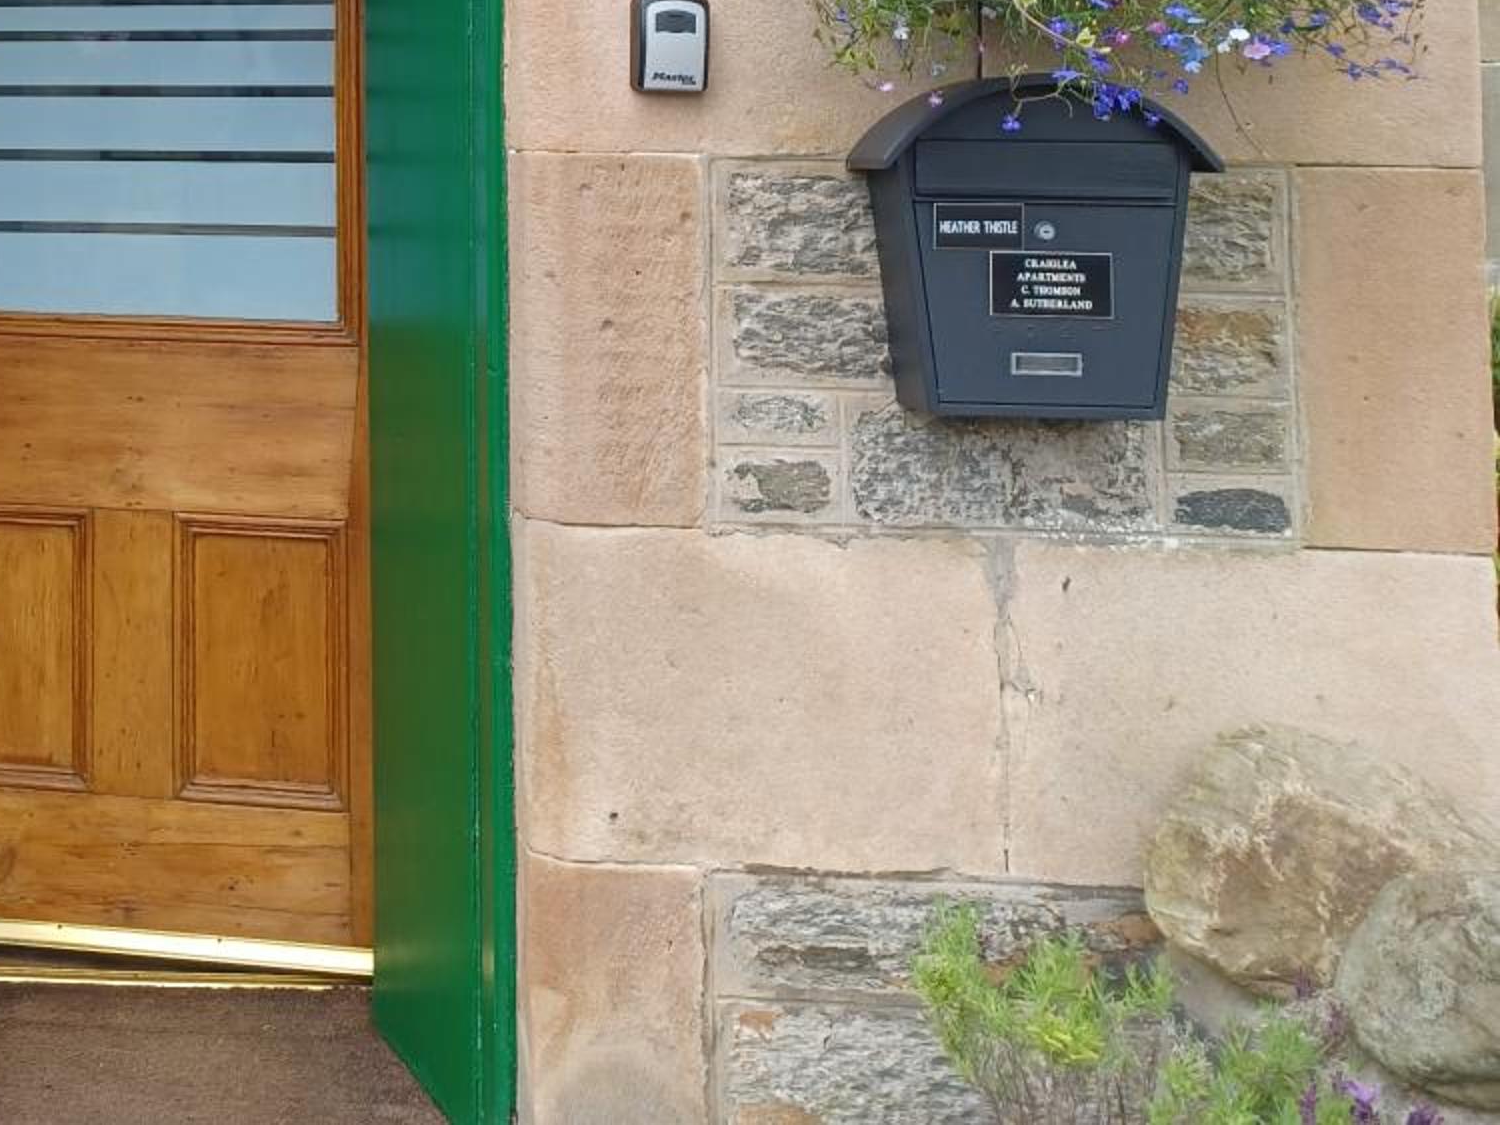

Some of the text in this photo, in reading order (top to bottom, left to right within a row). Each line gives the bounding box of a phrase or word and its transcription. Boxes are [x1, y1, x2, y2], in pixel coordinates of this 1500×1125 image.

[939, 220, 1019, 234] HEATHER THISTLE
[1016, 272, 1087, 283] APARTMENTS
[1023, 298, 1093, 310] SUTHERLAND
